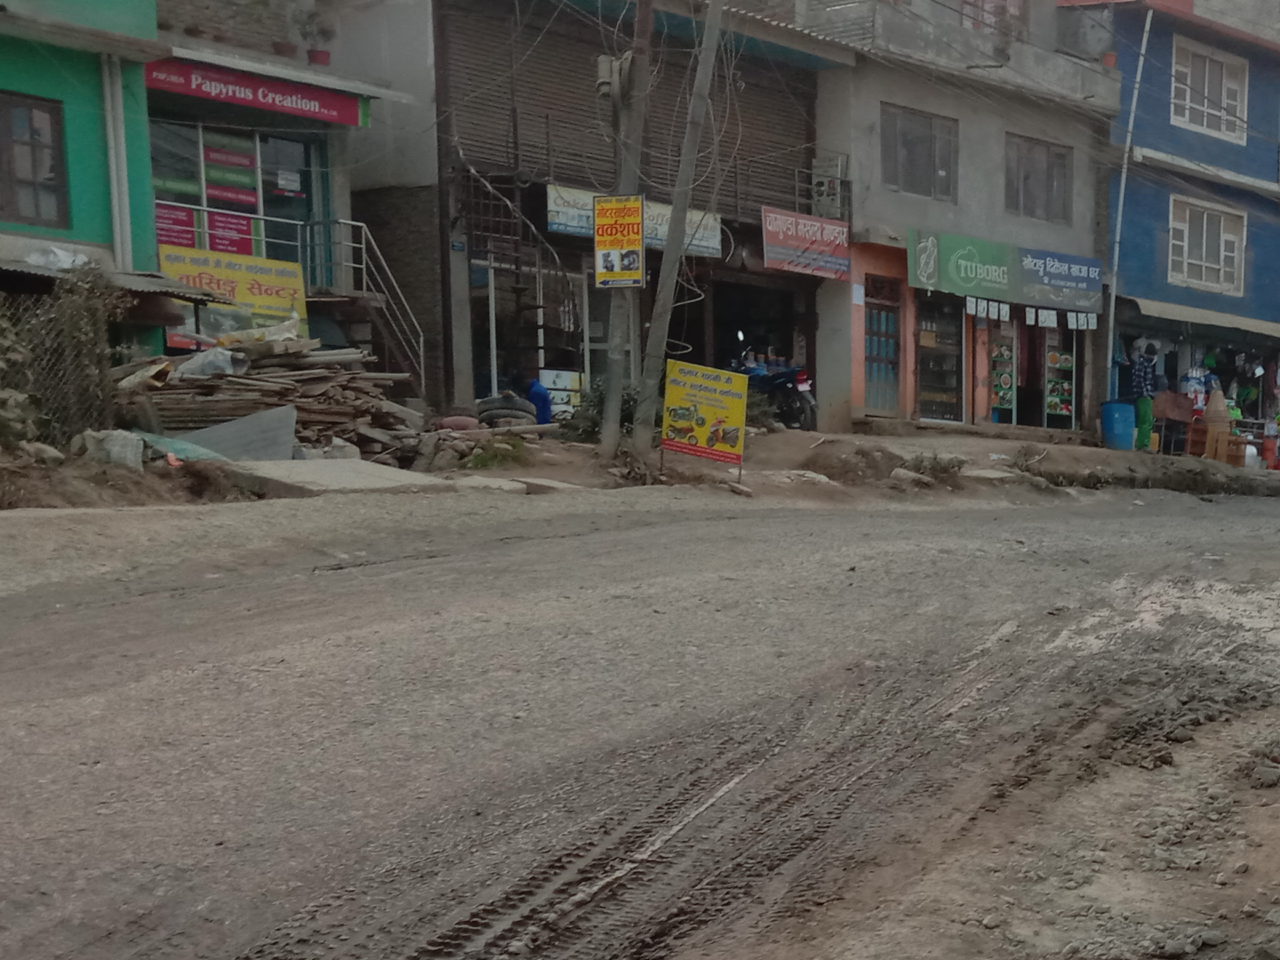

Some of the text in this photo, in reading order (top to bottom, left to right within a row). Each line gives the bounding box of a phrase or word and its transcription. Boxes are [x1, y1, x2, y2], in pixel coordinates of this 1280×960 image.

[190, 73, 254, 100] Papyrus
[258, 87, 320, 113] Creation
[596, 219, 641, 237] वर्कशप
[957, 259, 1008, 284] TUBORG
[247, 279, 300, 301] सेन्टर
